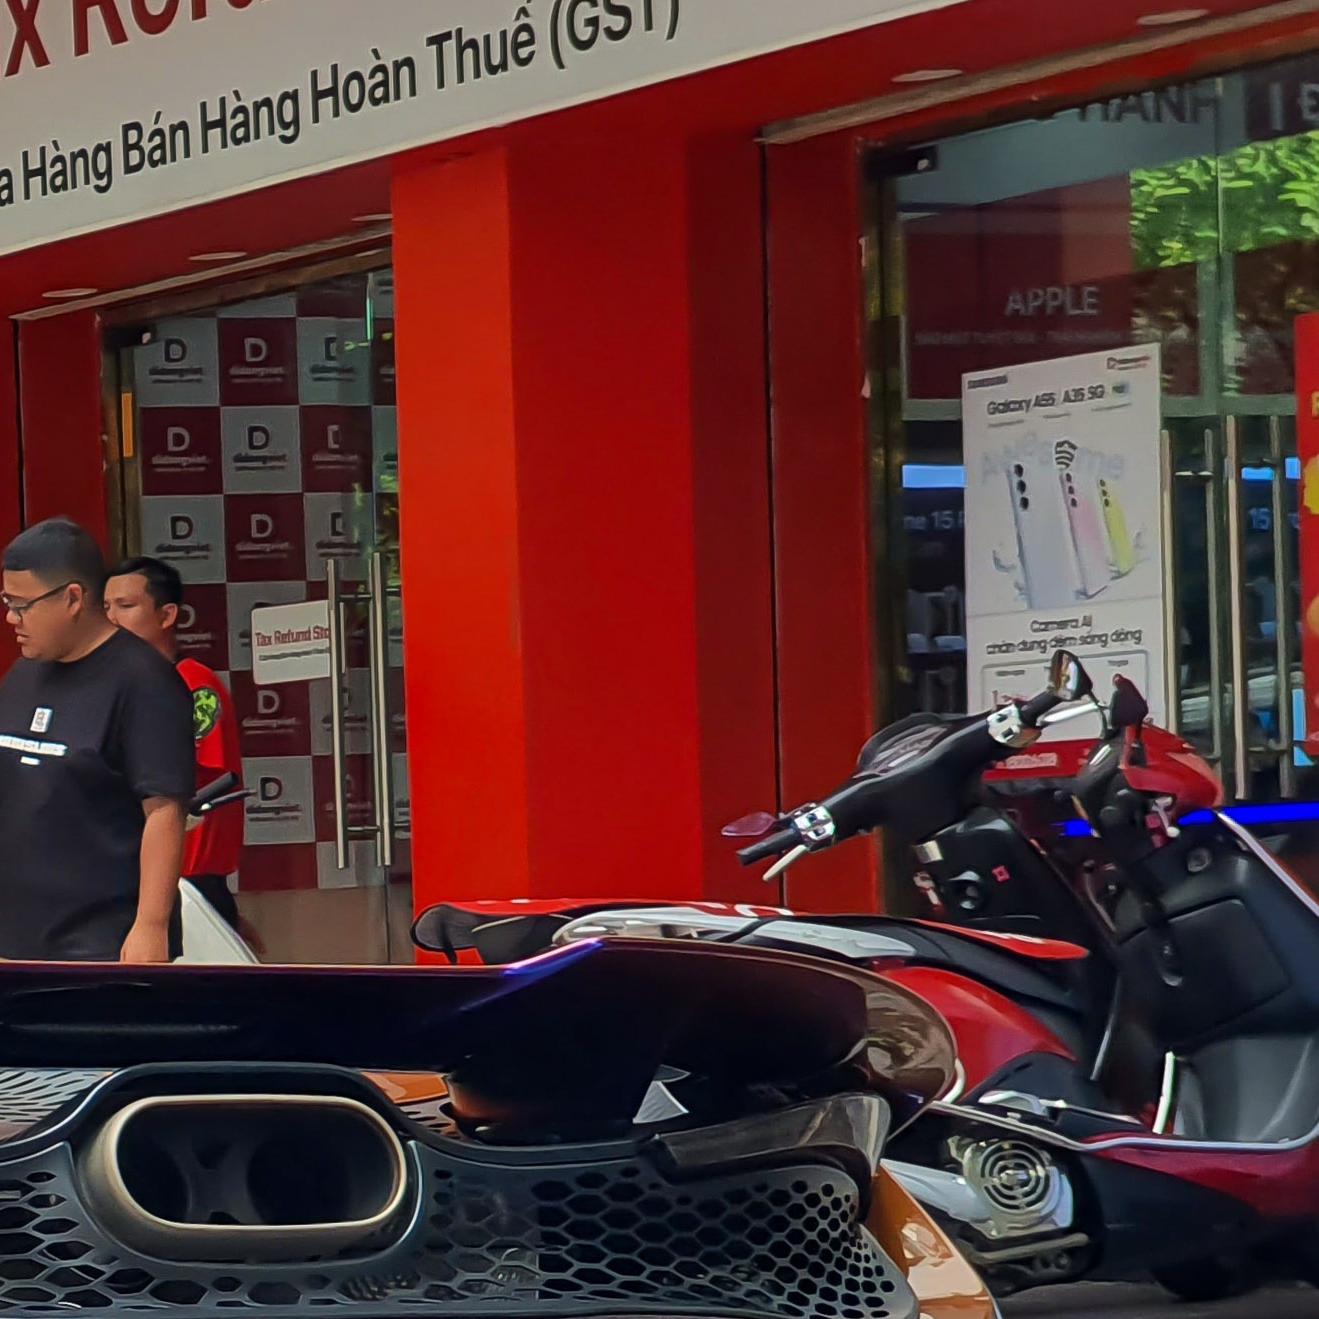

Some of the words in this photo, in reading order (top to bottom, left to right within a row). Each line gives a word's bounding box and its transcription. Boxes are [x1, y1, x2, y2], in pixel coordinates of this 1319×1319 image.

[21, 139, 113, 195] Hàng
[121, 111, 192, 176] Bán
[199, 89, 302, 145] Hàng
[310, 48, 418, 125] Hoàn
